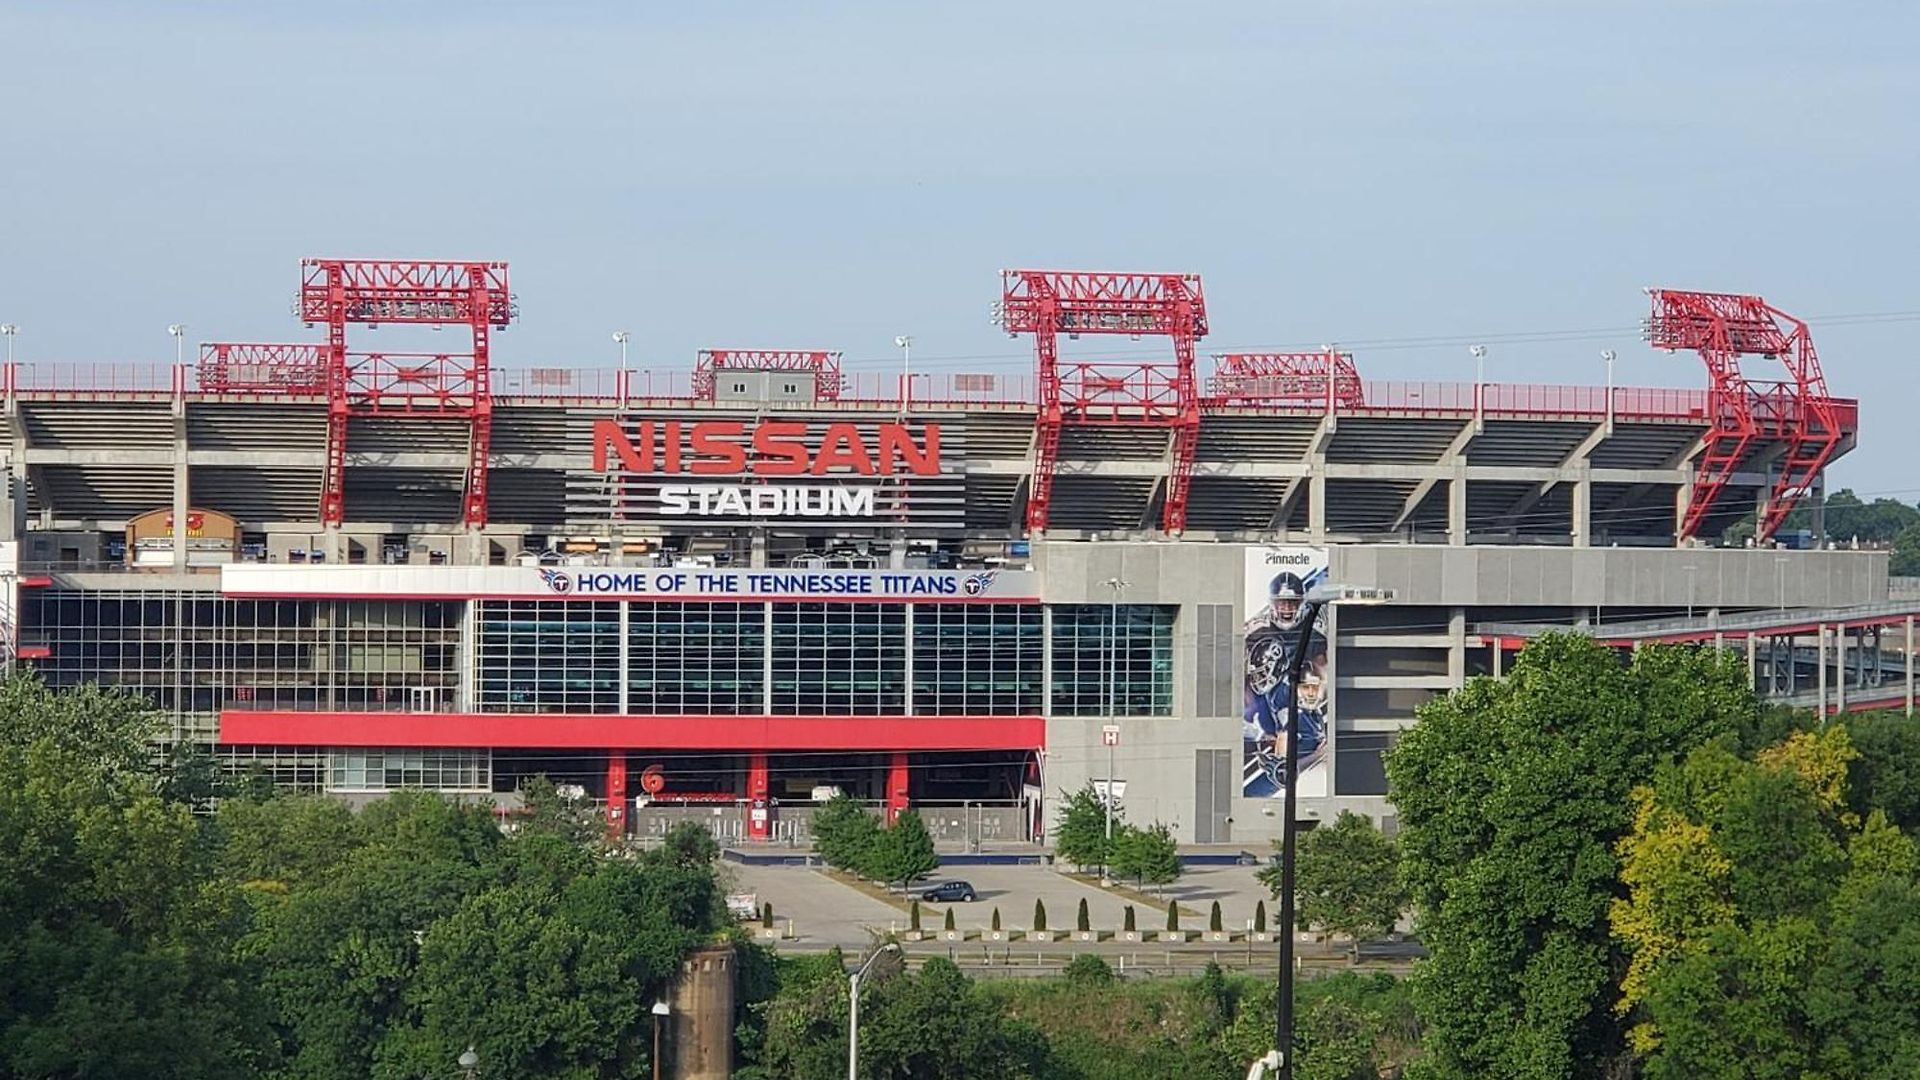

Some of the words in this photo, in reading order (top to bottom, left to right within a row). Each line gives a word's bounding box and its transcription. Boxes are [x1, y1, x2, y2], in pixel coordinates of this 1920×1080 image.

[593, 419, 941, 475] NISSAN
[659, 486, 874, 516] STADIUM
[1265, 553, 1310, 565] Pinnacle
[577, 573, 646, 592] HOME
[655, 573, 687, 592] OF
[695, 574, 738, 592] THE
[746, 574, 872, 593] TENNESSEE
[880, 575, 957, 594] TITANS
[1105, 732, 1117, 745] H
